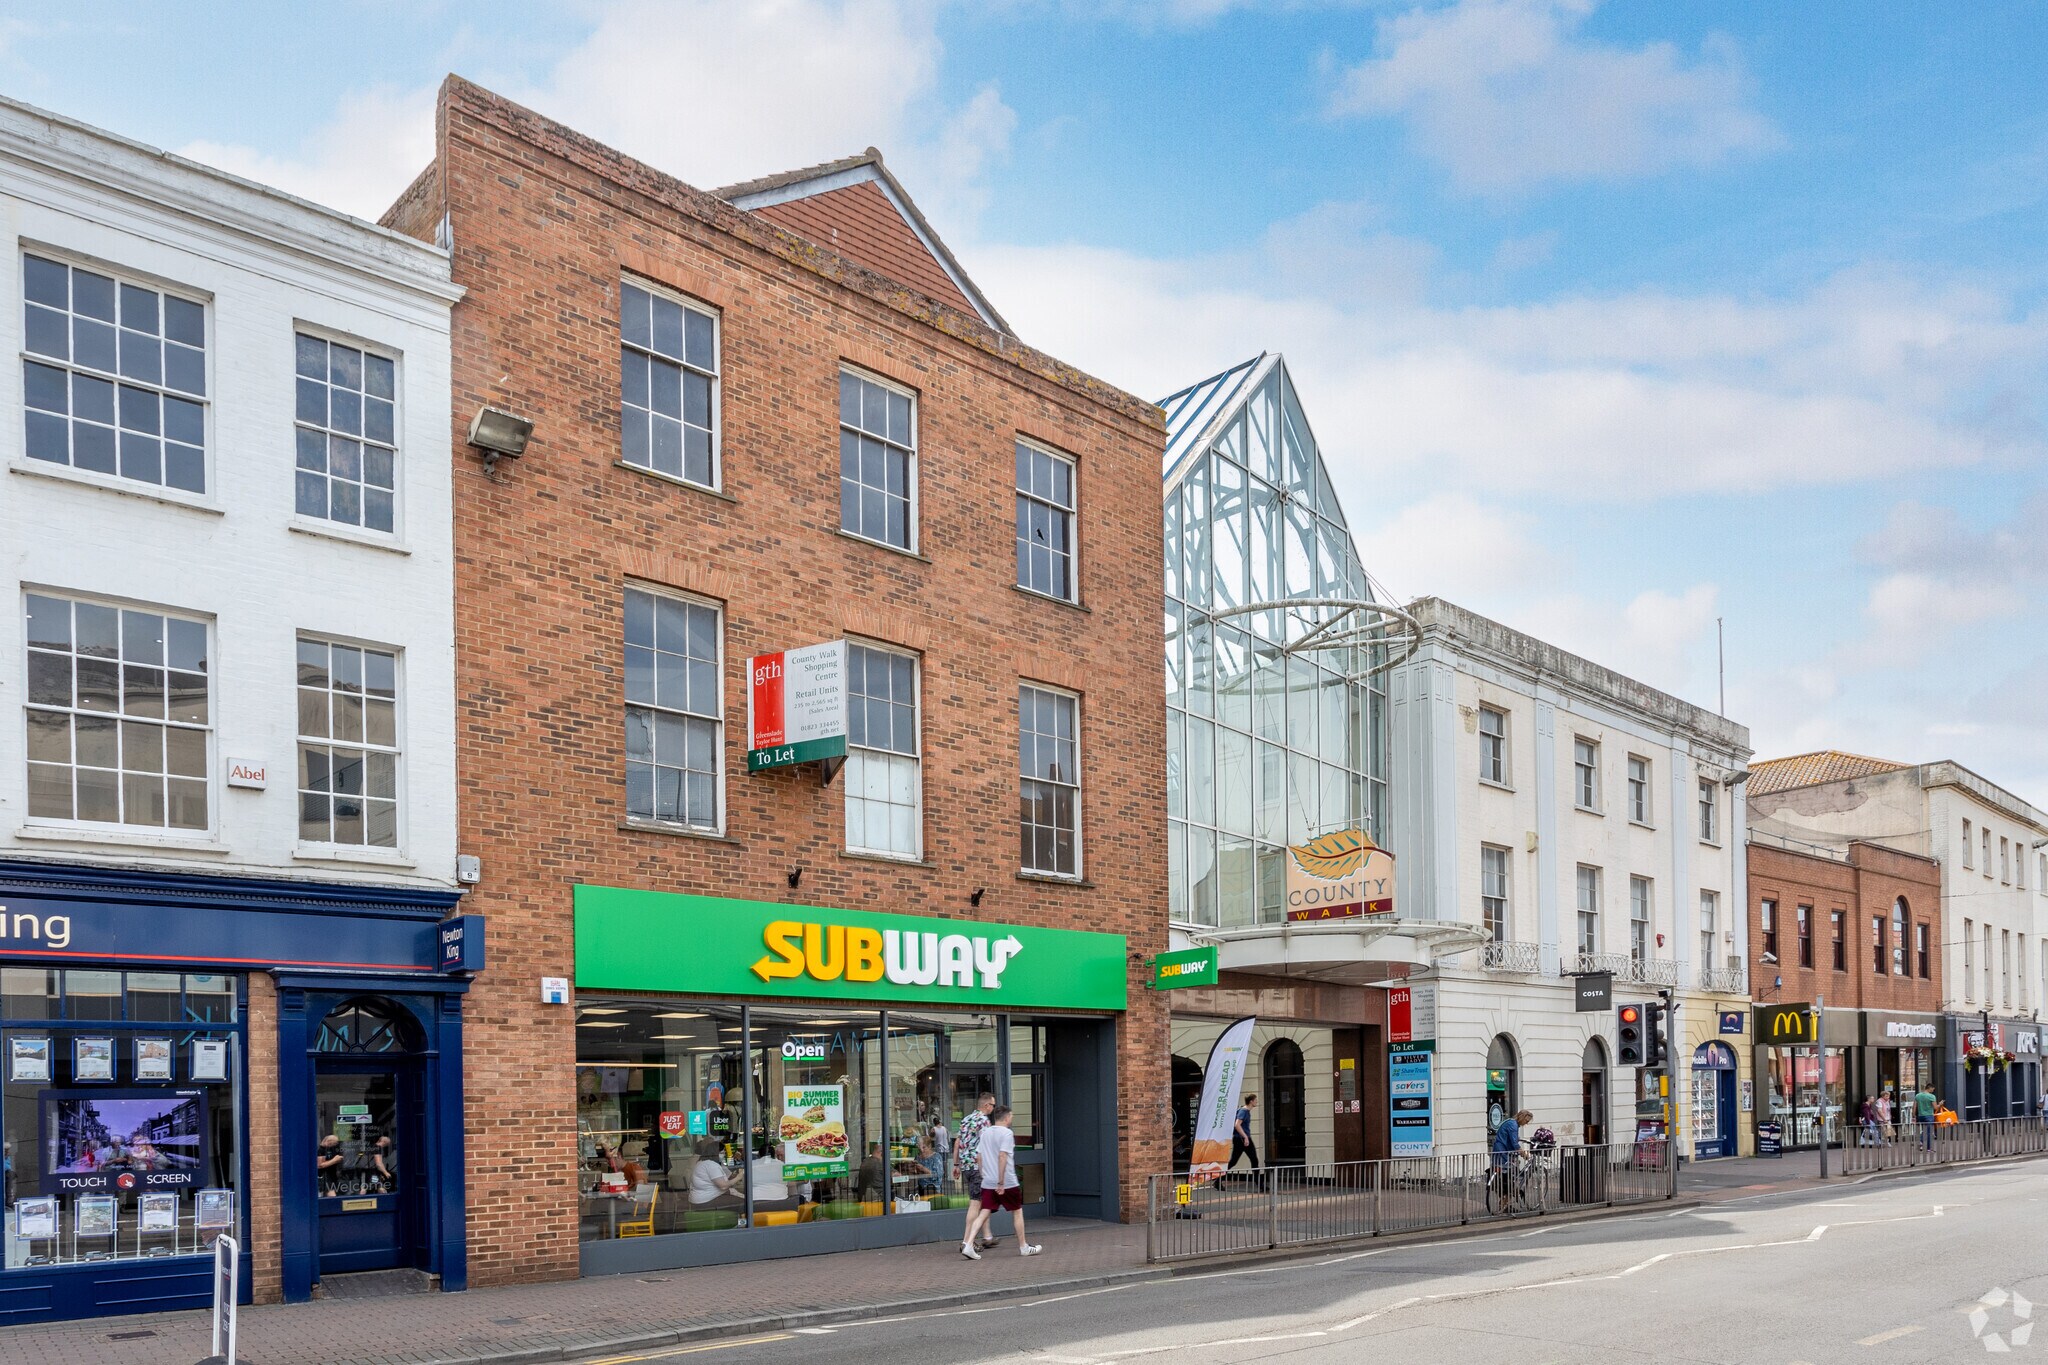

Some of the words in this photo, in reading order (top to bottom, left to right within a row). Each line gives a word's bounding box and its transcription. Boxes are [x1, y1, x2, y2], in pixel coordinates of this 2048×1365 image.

[792, 656, 816, 664] County
[819, 650, 837, 660] Walk
[755, 661, 782, 686] gth
[804, 660, 838, 672] Shopping
[815, 672, 838, 681] Centre
[796, 688, 817, 699] Retail
[819, 685, 838, 695] Units
[757, 751, 771, 765] To
[775, 748, 794, 762] Let
[231, 765, 264, 781] Abel
[1289, 878, 1387, 906] COUNTY
[442, 928, 463, 944] Newton
[447, 945, 459, 959] King
[750, 920, 1023, 989] SUBWAY
[1160, 960, 1208, 978] SUBWAY
[1391, 991, 1409, 1006] gth
[1887, 1022, 1936, 1038] McDonald's
[2017, 1032, 2038, 1053] KFC
[782, 1042, 824, 1060] Open
[1693, 1056, 1707, 1064] Mobile
[1719, 1056, 1727, 1064] Pro
[1219, 1060, 1230, 1093] AHEAD
[1396, 1081, 1424, 1090] savers
[788, 1098, 839, 1107] FLAVOURS
[663, 1116, 681, 1124] JUST
[667, 1122, 681, 1130] EAT
[60, 1177, 106, 1188] TOUCH
[147, 1174, 191, 1184] SCREEN
[325, 1180, 391, 1192] Welcome
[1179, 1186, 1188, 1202] H
